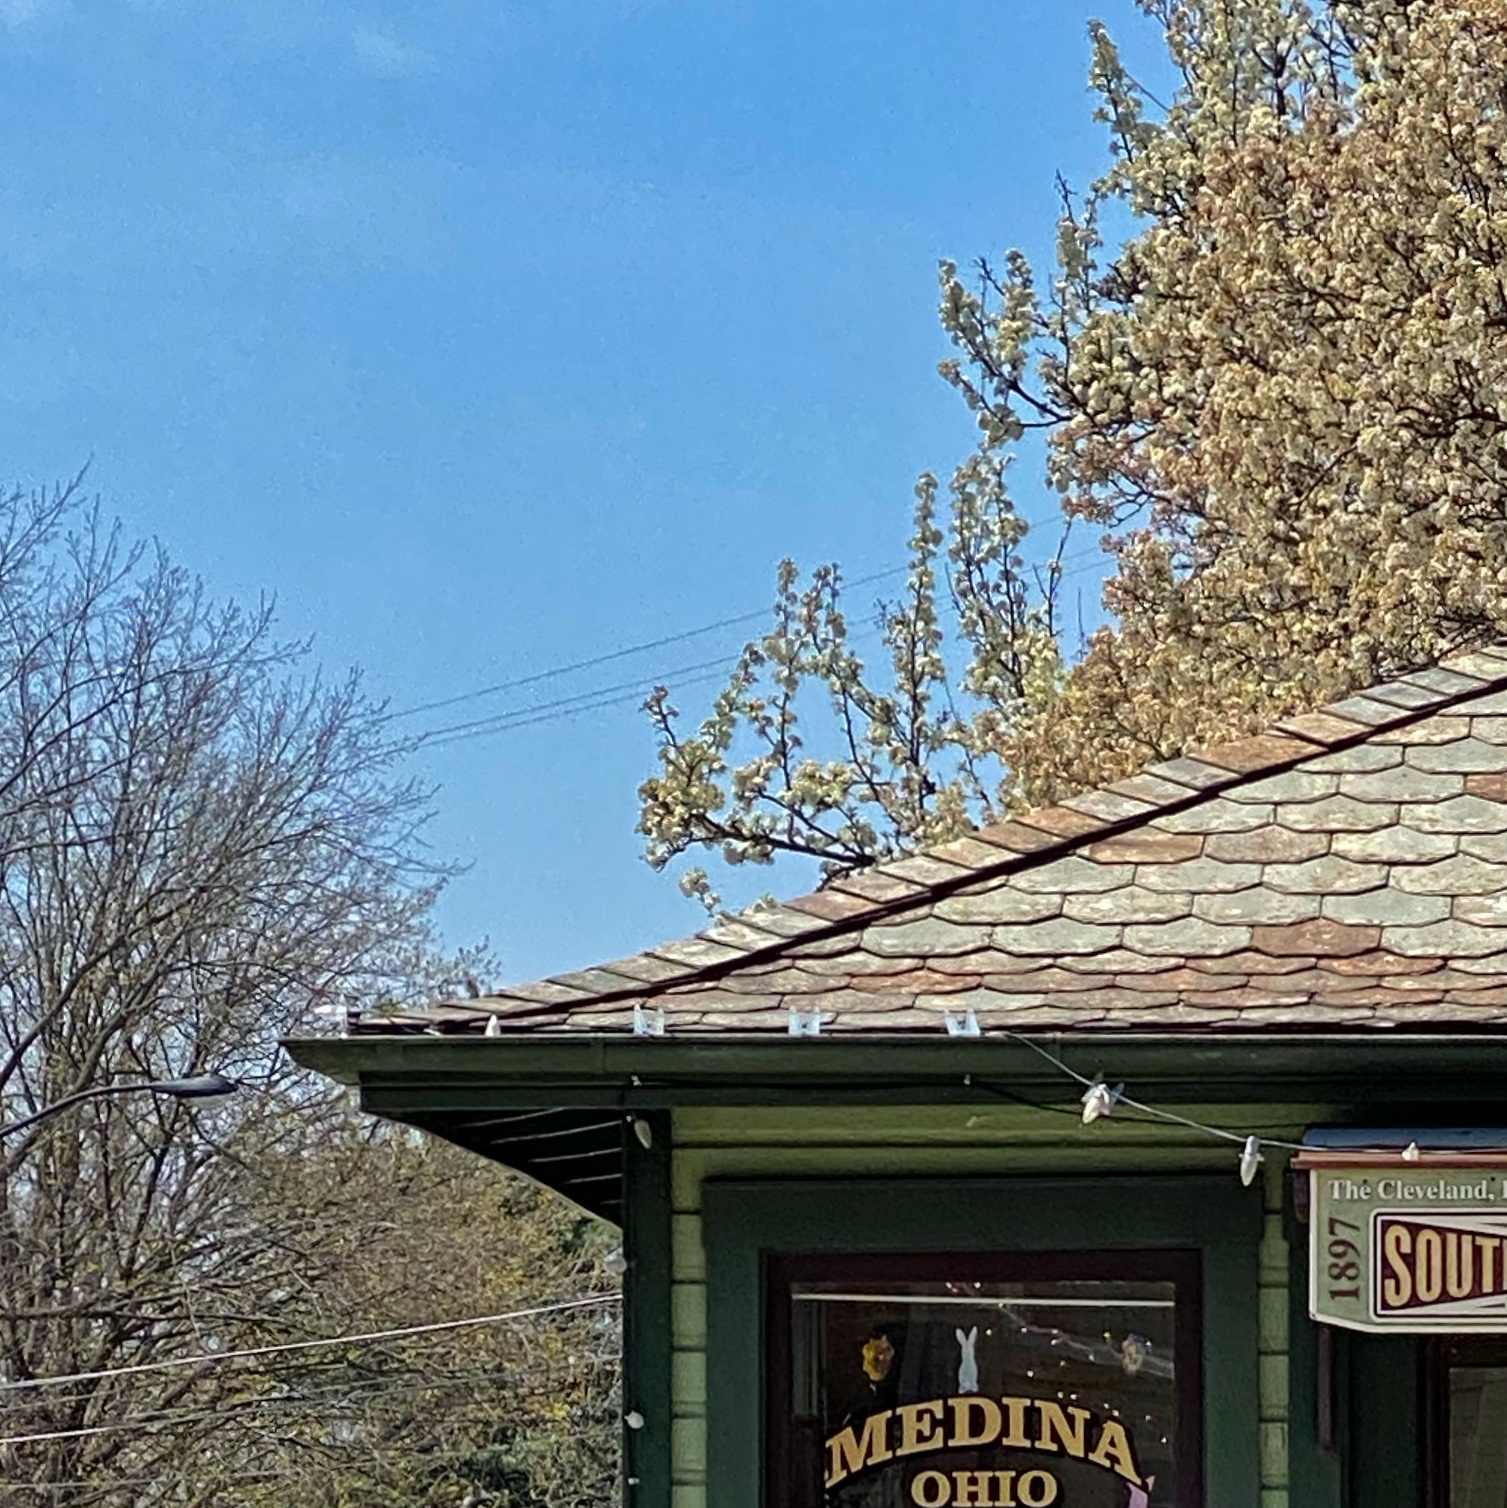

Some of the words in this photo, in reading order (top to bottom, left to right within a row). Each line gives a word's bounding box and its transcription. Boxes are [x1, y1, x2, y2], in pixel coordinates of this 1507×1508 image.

[1328, 1179, 1371, 1200] The
[1377, 1179, 1495, 1202] Cleveland,
[1328, 1217, 1361, 1301] 1897
[824, 1396, 1145, 1489] MEDINA
[911, 1470, 1058, 1508] OHIO
